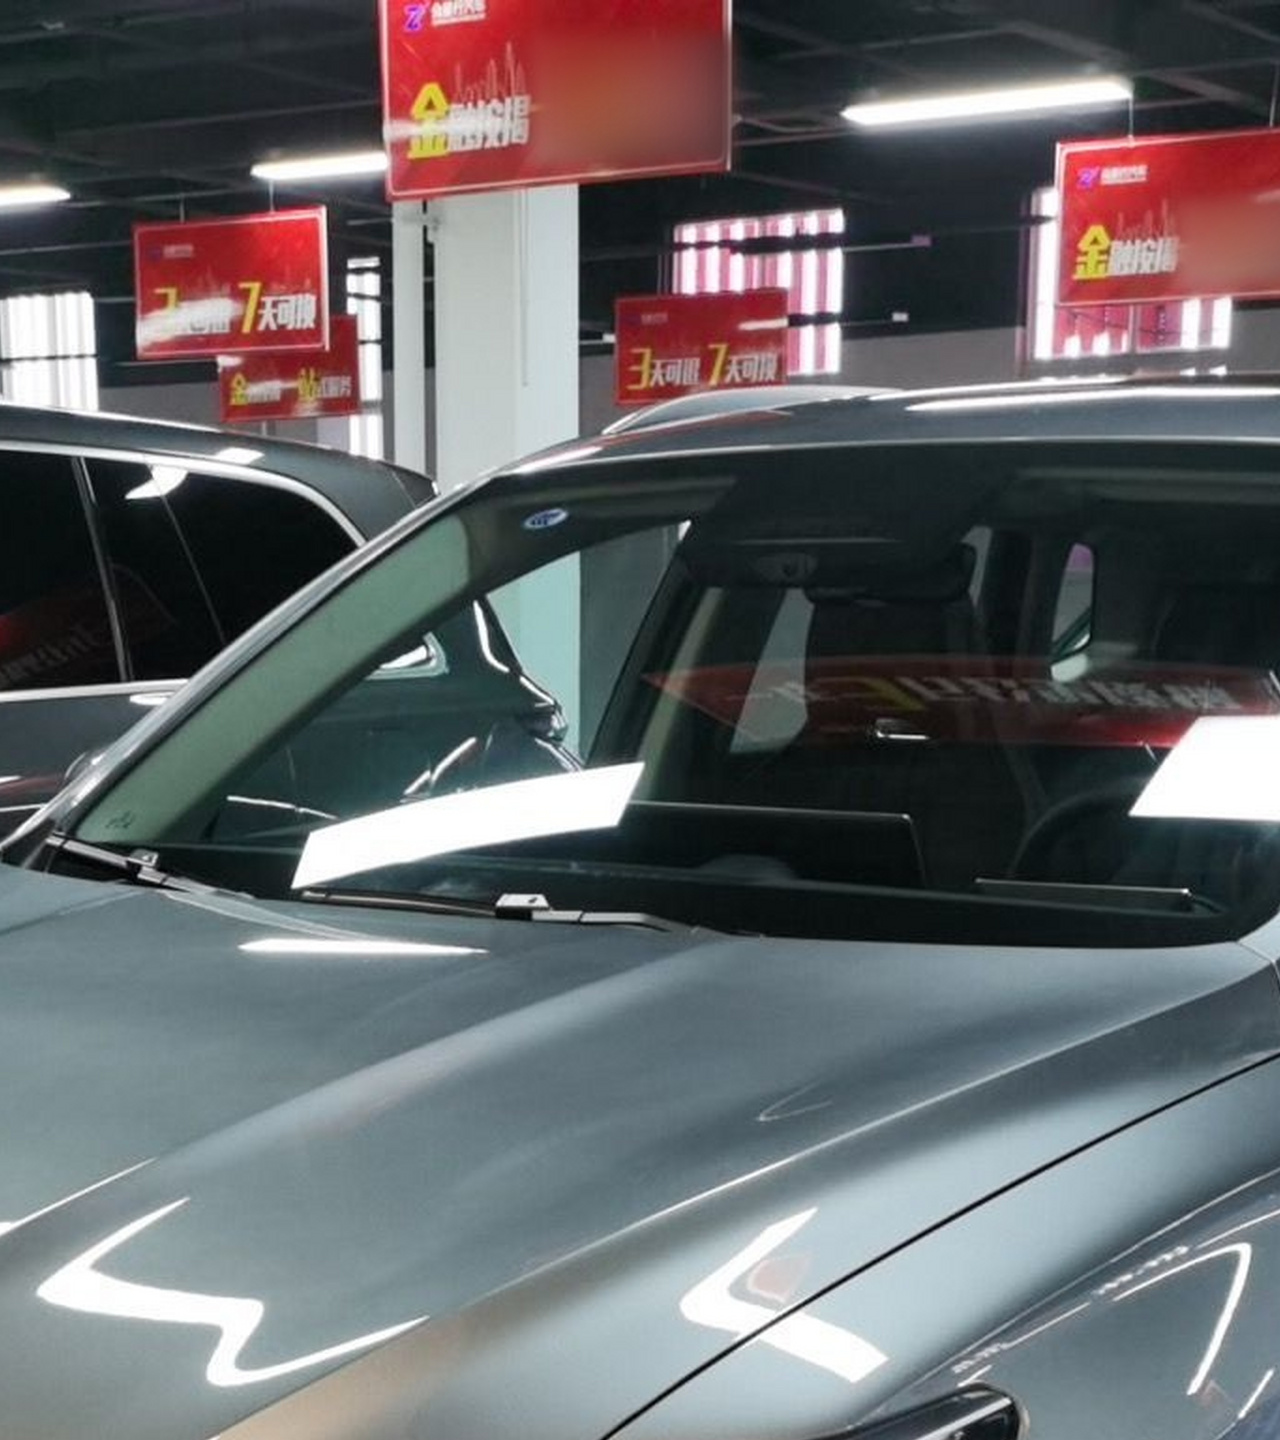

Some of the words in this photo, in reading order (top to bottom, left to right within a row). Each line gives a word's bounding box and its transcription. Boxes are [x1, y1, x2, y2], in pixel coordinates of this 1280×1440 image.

[626, 347, 701, 390] 3天可退
[706, 343, 778, 387] 7天可换
